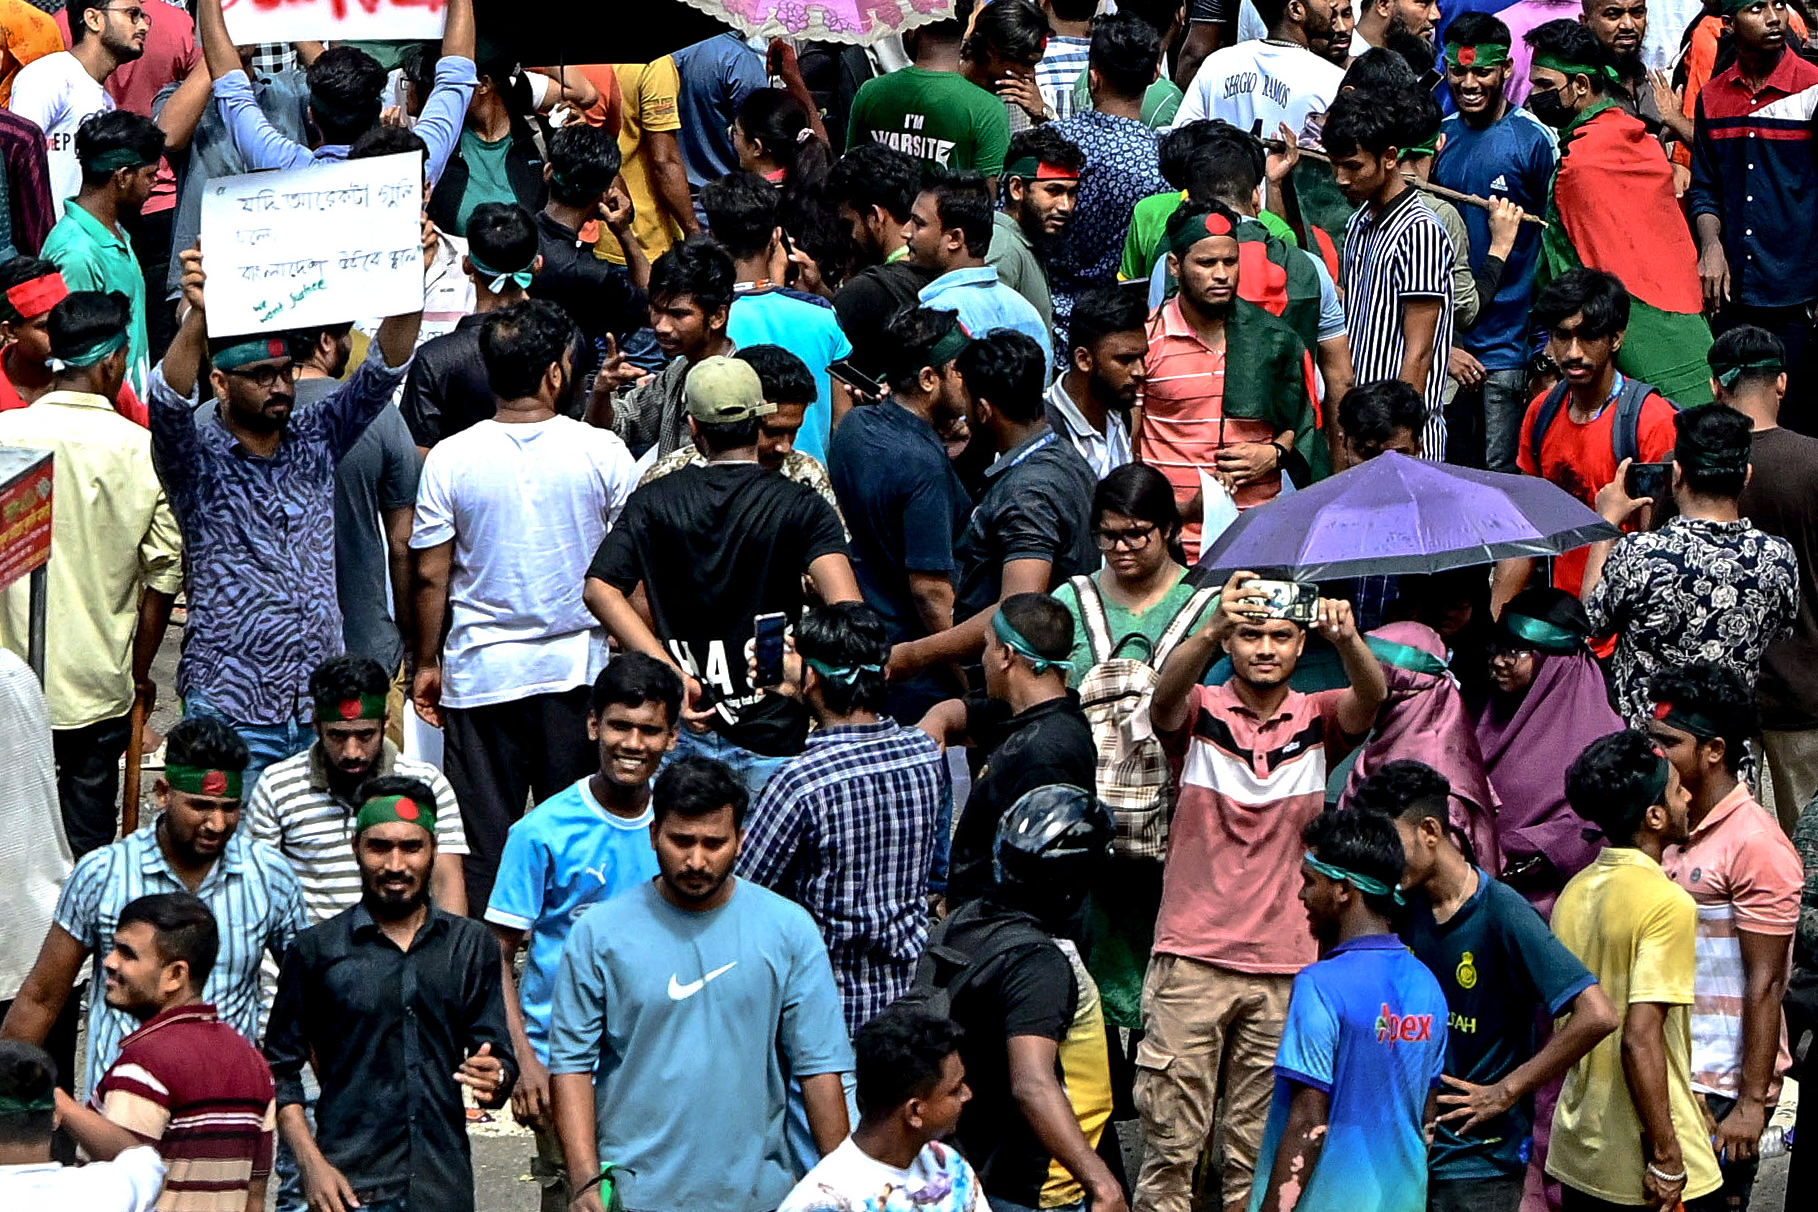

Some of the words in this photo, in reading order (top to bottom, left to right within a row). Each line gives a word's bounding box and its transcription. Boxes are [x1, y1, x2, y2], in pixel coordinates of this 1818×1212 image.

[1223, 72, 1258, 100] SERGIO
[1261, 74, 1292, 110] RAMOS
[904, 113, 925, 130] I'M
